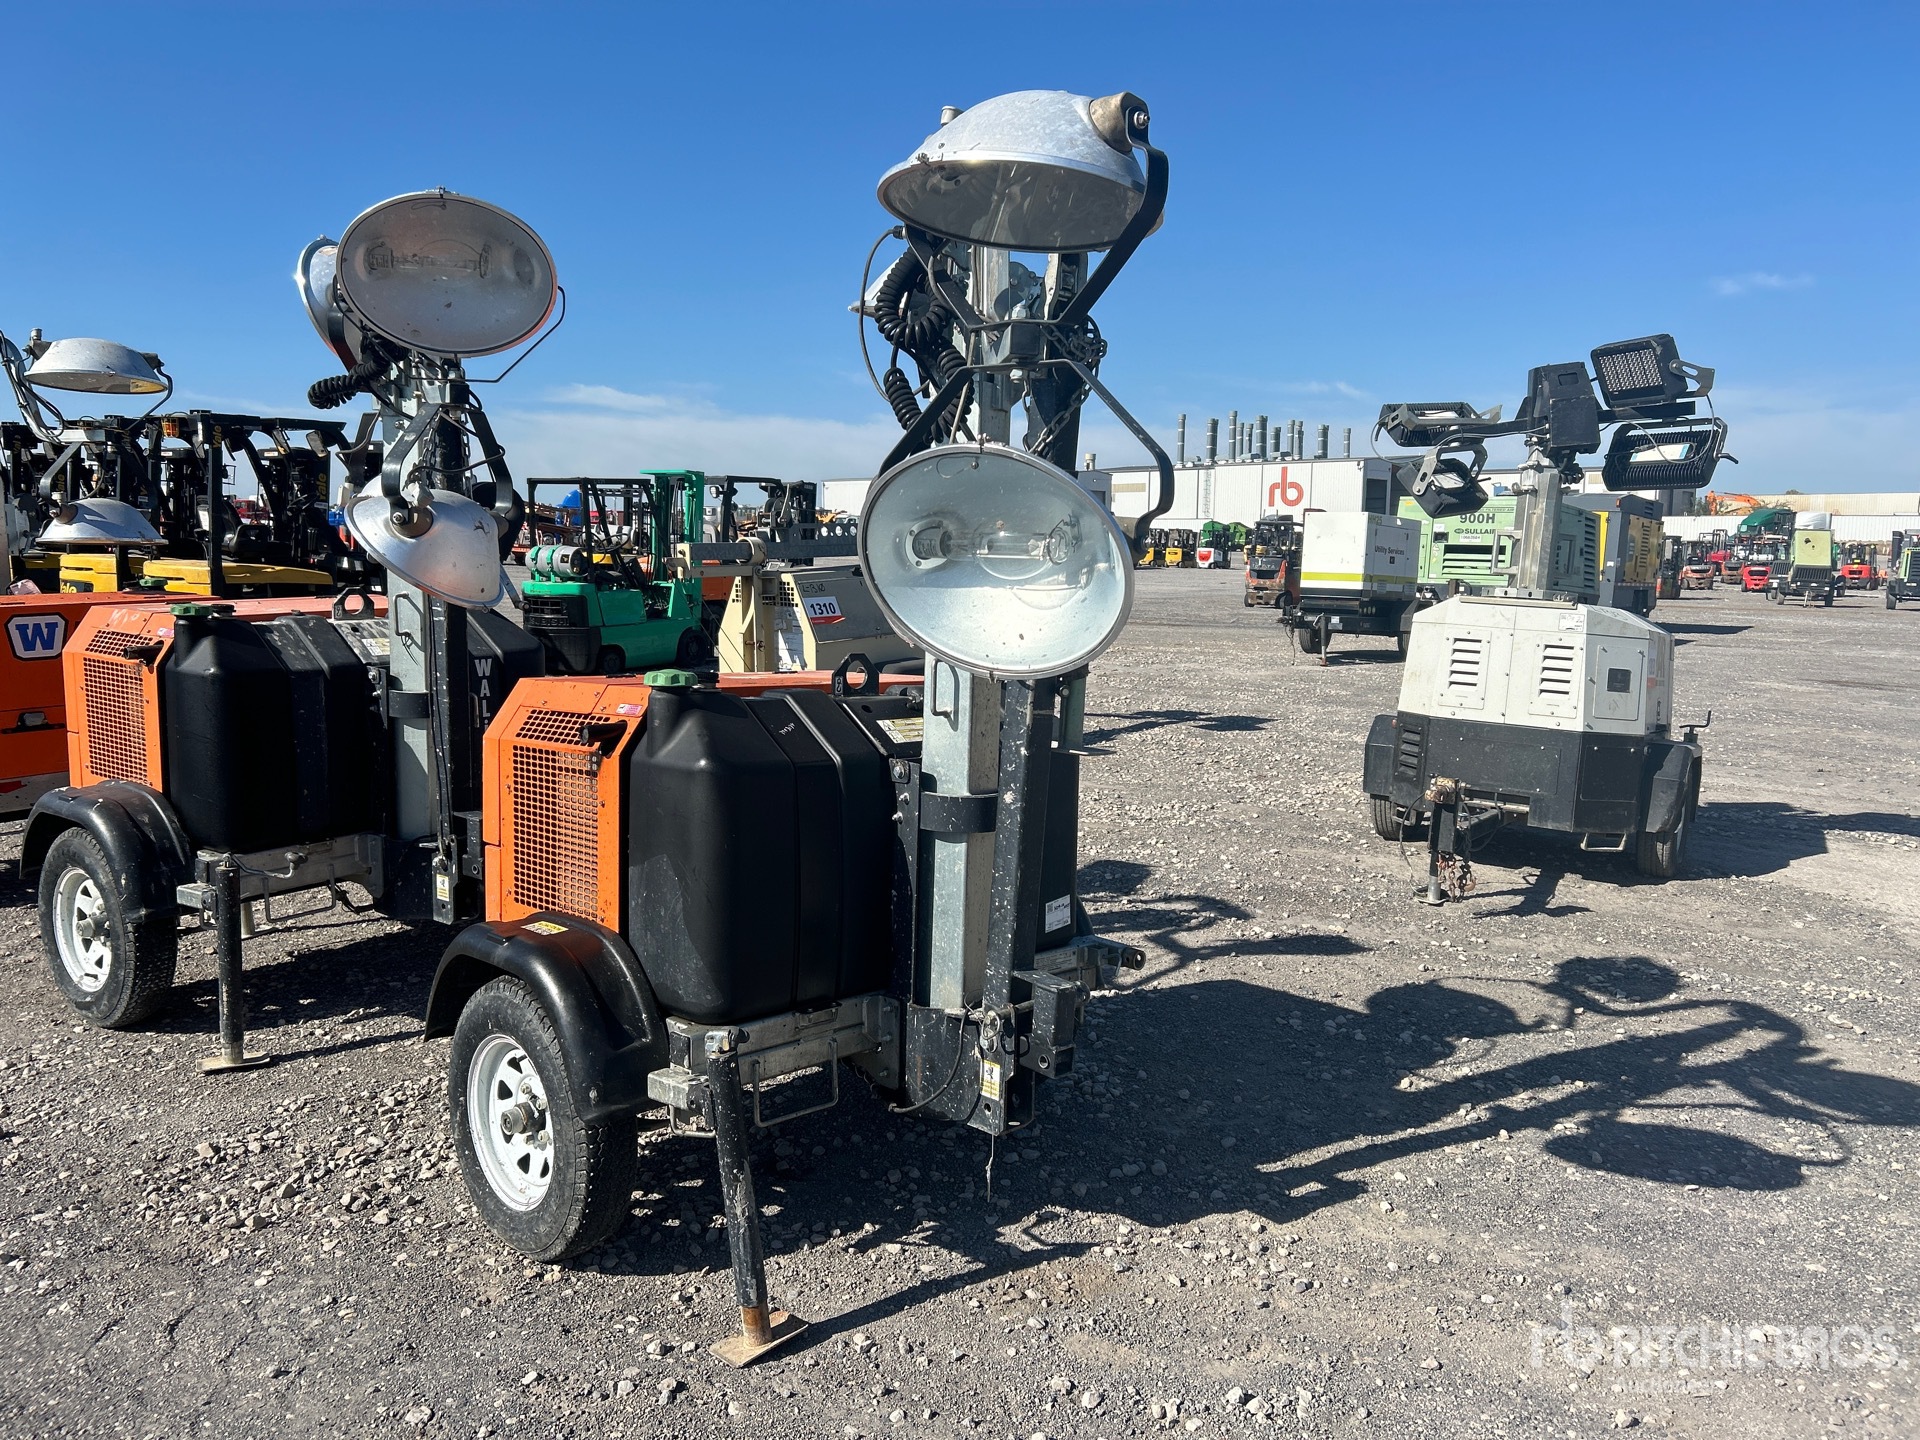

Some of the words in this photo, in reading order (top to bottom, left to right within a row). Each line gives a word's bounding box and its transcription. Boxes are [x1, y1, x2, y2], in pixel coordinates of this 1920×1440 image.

[213, 425, 222, 448] Yale
[1268, 466, 1304, 507] rb
[1459, 513, 1495, 524] 900H
[1374, 545, 1387, 556] Utility
[1387, 547, 1405, 556] Services
[810, 602, 836, 616] 1310
[15, 621, 59, 652] W
